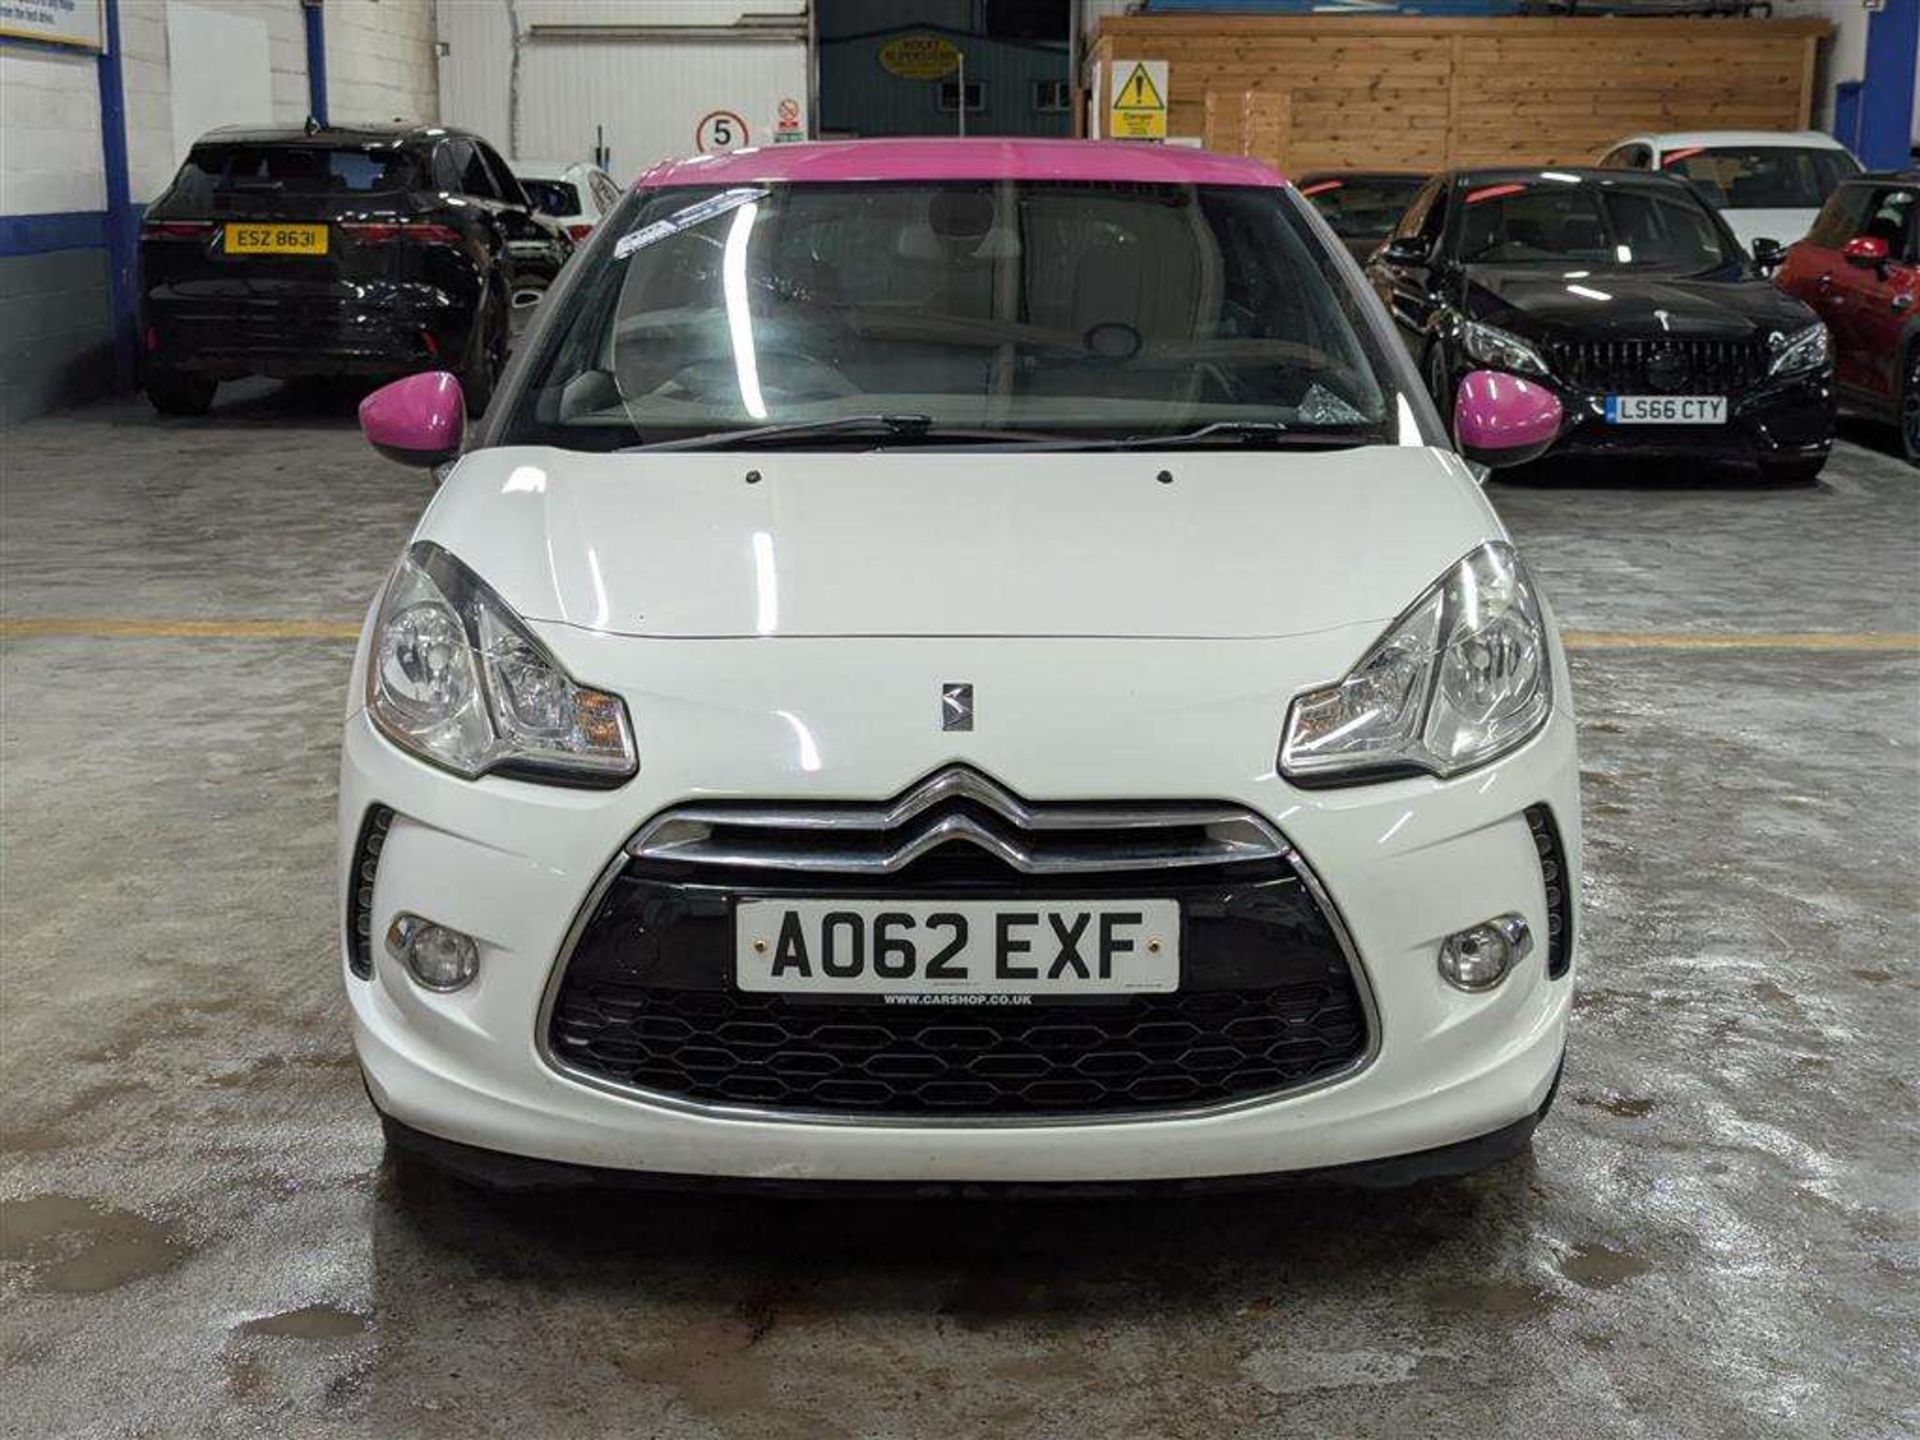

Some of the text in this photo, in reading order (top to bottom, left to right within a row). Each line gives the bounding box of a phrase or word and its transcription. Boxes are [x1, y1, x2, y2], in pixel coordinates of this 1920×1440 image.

[714, 119, 731, 145] 5
[237, 230, 315, 247] ESZ 8631
[1621, 400, 1722, 419] LS66 CTY
[995, 912, 1143, 979] EXF
[884, 995, 1032, 1005] WWW.CARSHOP.CO.UK
